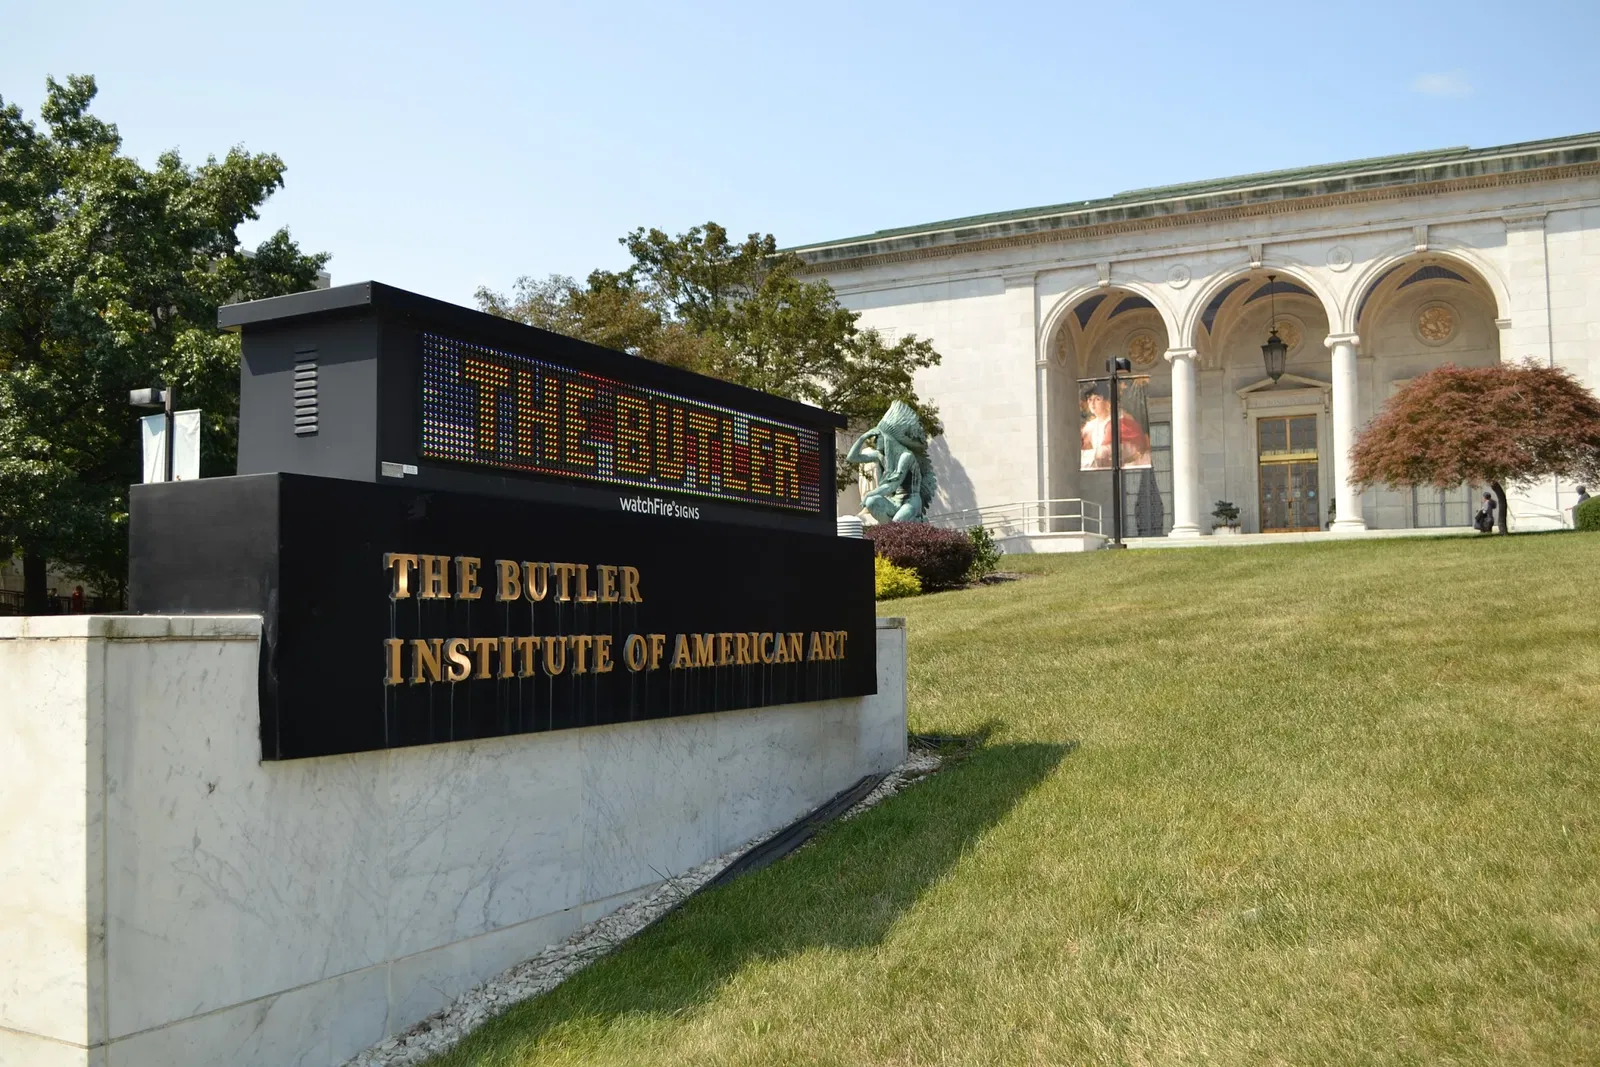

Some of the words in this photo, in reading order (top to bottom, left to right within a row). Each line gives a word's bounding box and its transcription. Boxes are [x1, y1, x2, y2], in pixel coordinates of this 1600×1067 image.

[464, 358, 599, 468] THE
[616, 395, 801, 501] BUTLER
[675, 505, 700, 519] SIGNS
[382, 551, 483, 602] THE
[494, 558, 643, 605] BUTLER
[382, 634, 614, 687] INSTITUTE
[623, 633, 666, 673] OF
[670, 632, 803, 670] AMERICAN
[806, 629, 849, 663] ART
